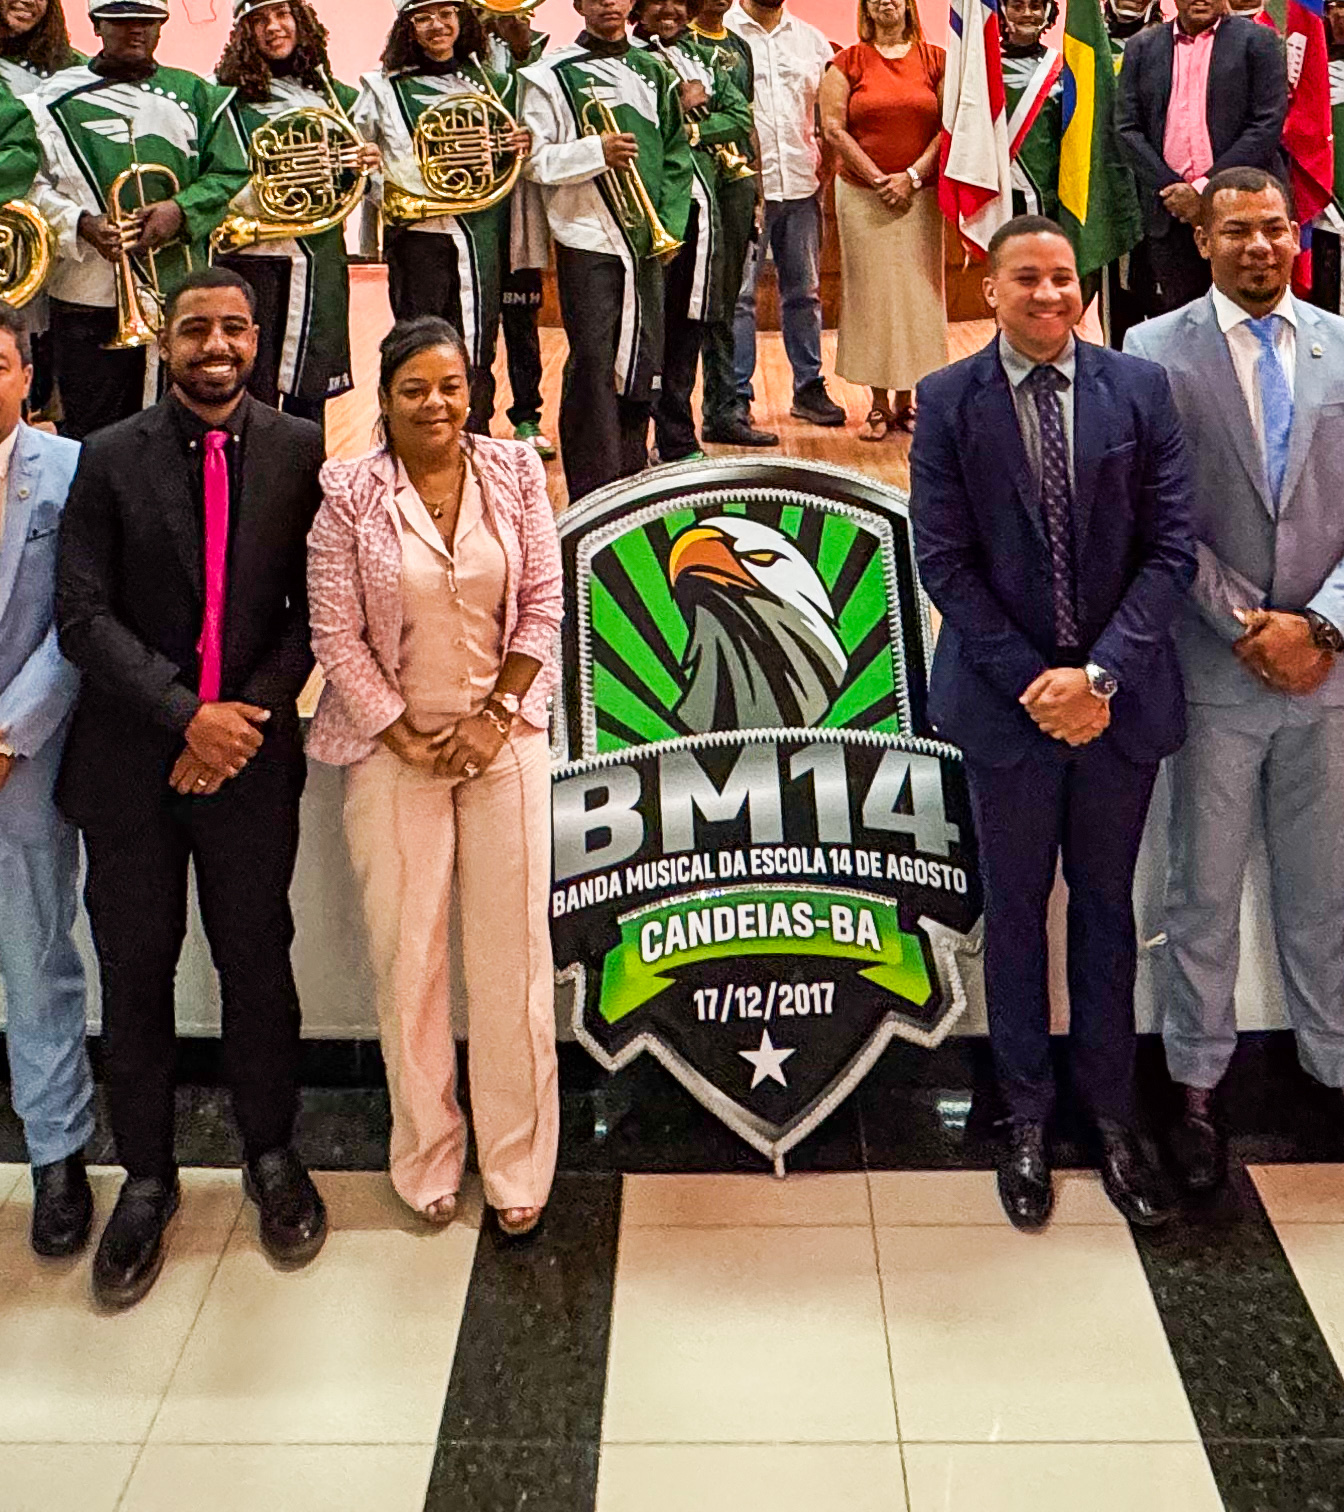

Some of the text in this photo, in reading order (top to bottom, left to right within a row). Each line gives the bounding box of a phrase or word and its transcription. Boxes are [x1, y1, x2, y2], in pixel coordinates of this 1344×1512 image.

[552, 743, 960, 883] BM14
[552, 847, 967, 918] BANDA MUSICAL DA ESCOLA 14 DE AGOSTO
[641, 902, 881, 963] CANDEIAS-BA
[693, 982, 834, 1022] 17/12/2017
